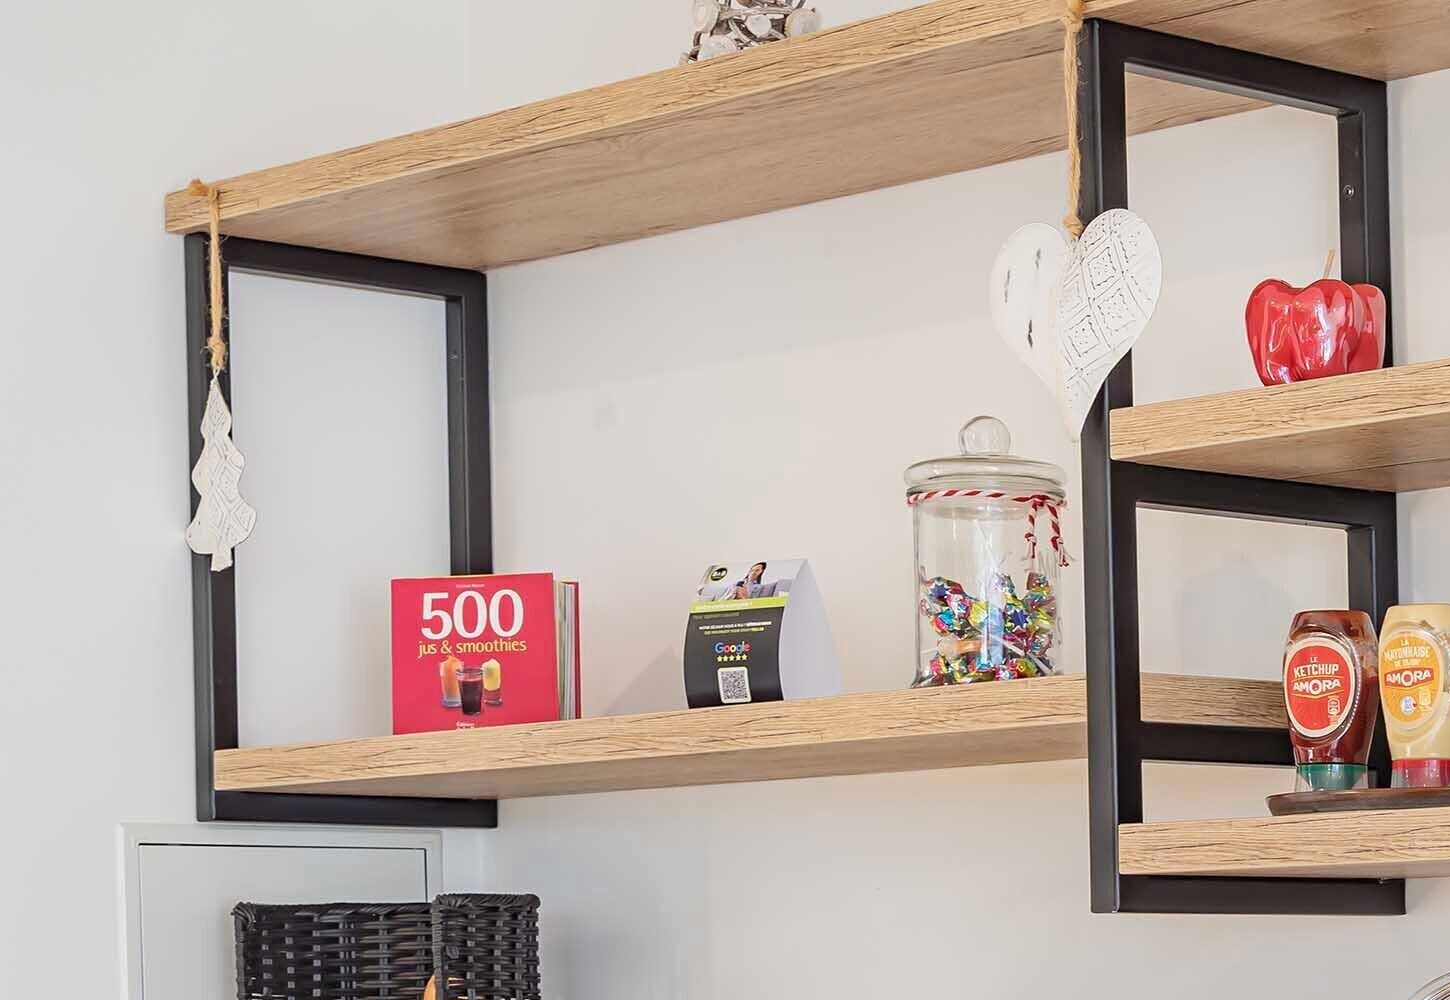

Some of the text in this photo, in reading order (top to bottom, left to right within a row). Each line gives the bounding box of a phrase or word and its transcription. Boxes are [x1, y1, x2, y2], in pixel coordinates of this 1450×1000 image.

[421, 589, 524, 640] 500
[417, 638, 527, 659] jus & smoothies
[714, 640, 751, 654] Google
[1384, 646, 1431, 662] MAYONNAISE
[1293, 663, 1339, 678] KETCHUP
[1386, 669, 1431, 686] AMORA
[1293, 679, 1341, 695] AMORA
